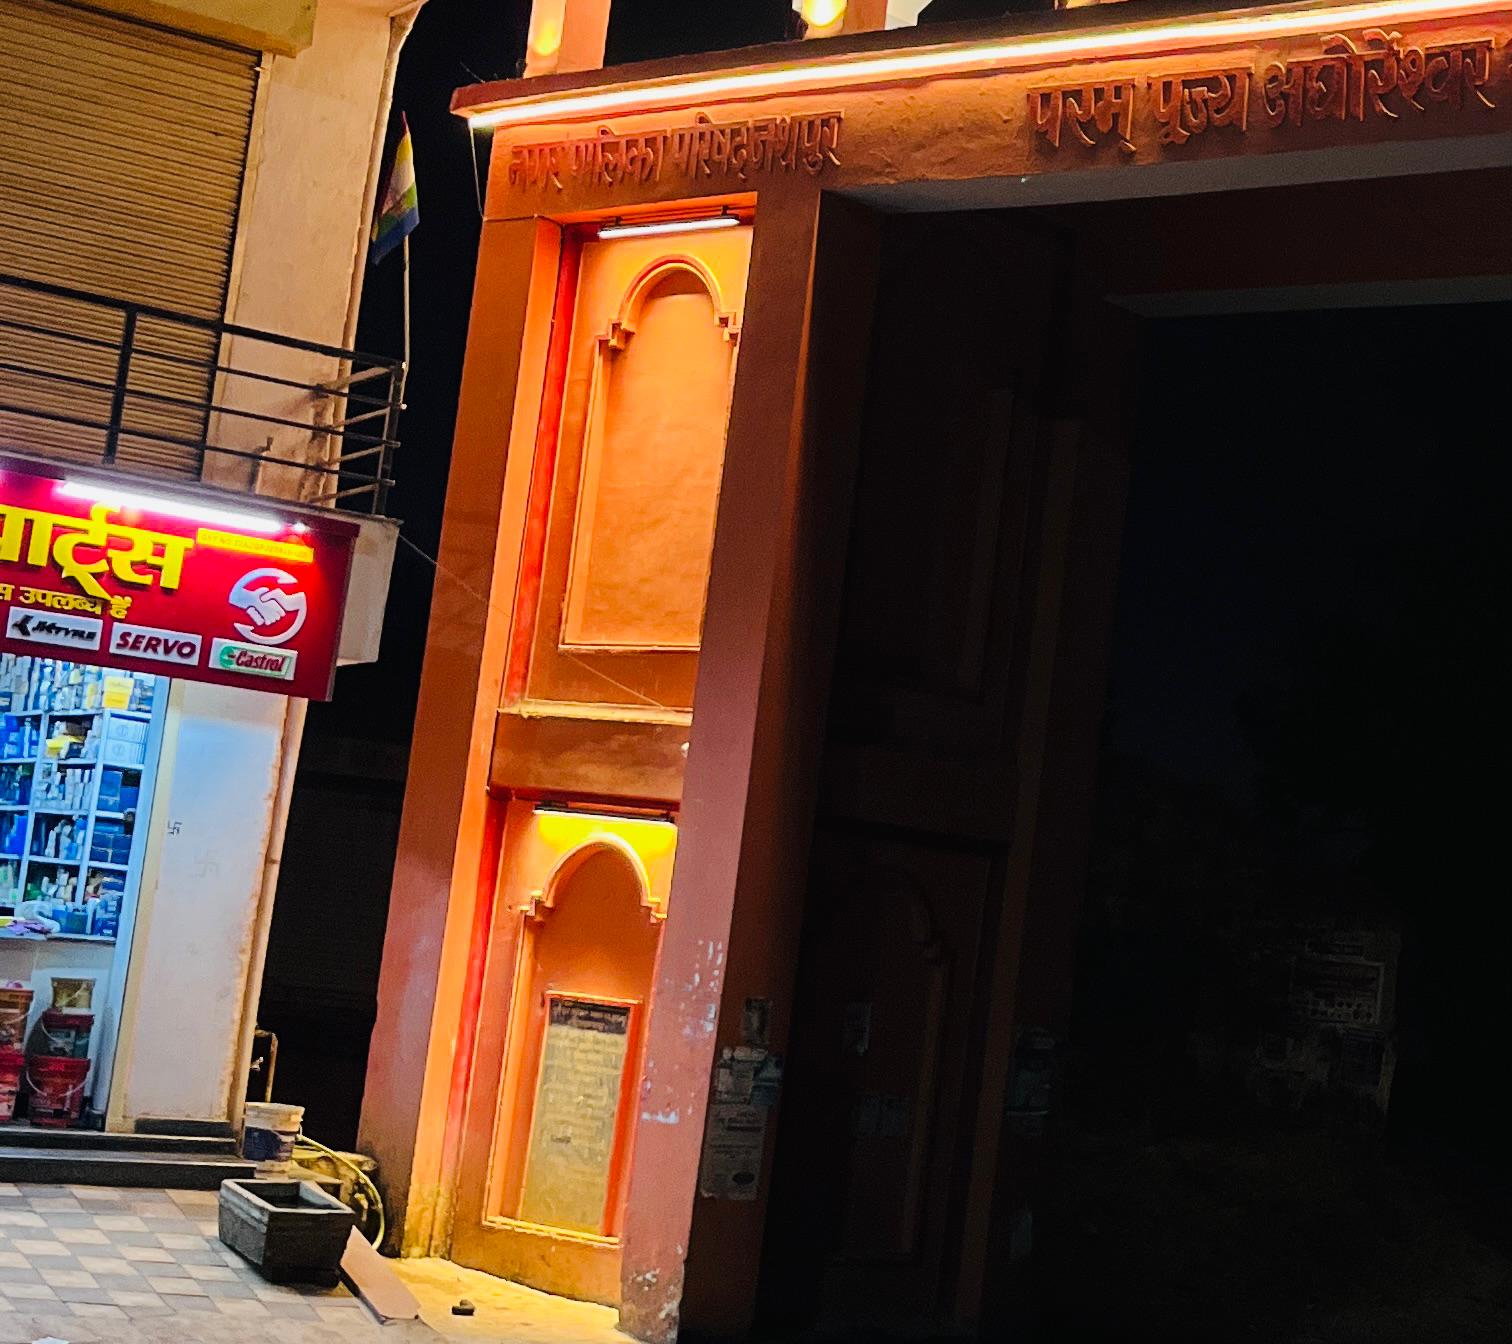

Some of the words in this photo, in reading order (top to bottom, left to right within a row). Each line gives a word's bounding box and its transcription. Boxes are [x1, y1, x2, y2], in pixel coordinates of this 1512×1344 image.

[1146, 65, 1255, 146] पूज्य
[116, 631, 197, 660] SERVO
[235, 649, 286, 673] Castrol
